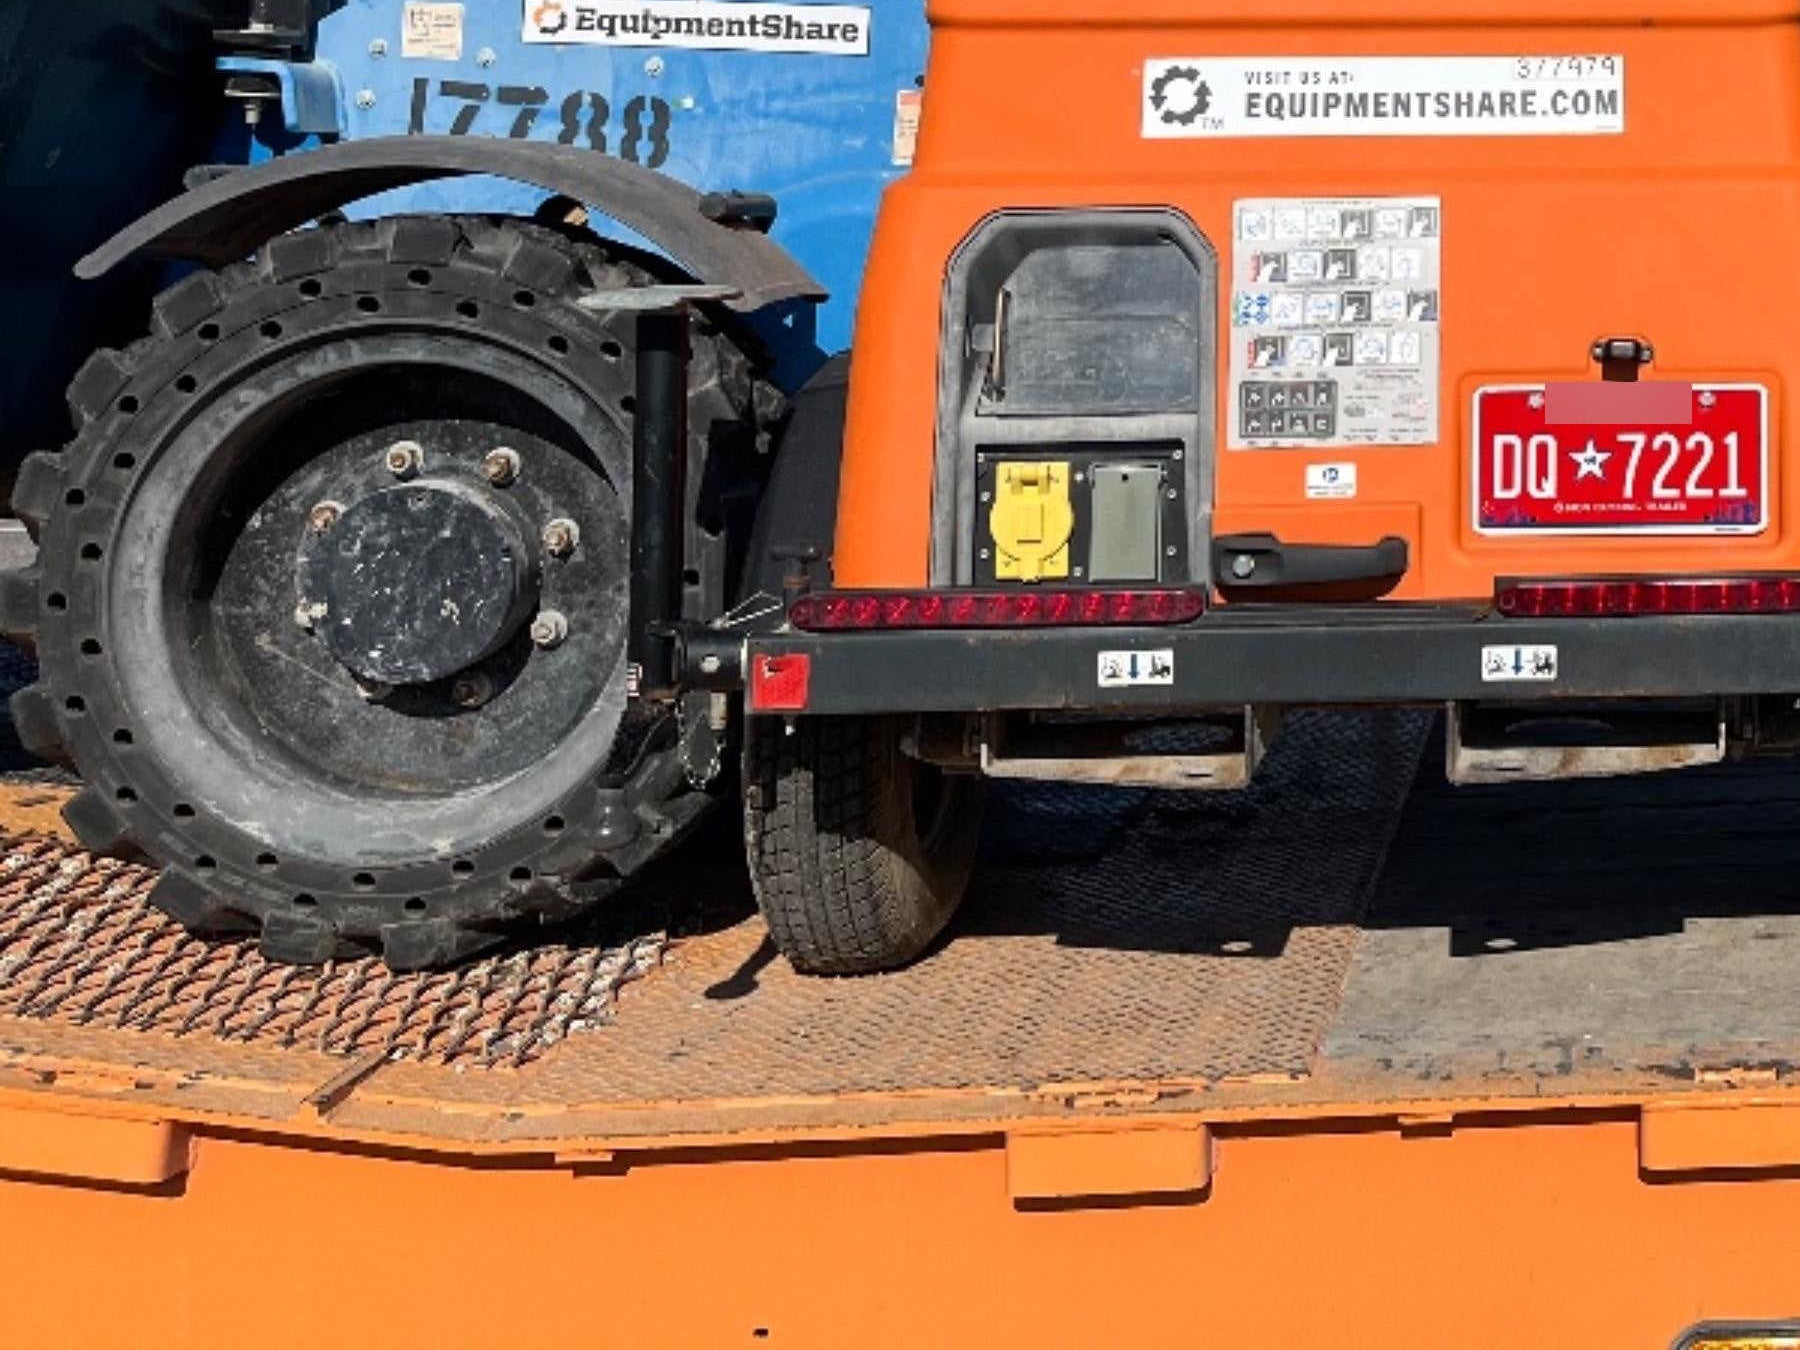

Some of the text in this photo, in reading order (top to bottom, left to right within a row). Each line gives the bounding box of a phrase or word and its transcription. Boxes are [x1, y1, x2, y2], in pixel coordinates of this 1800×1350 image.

[574, 5, 859, 44] EquipmentShare
[1300, 70, 1322, 85] US
[408, 77, 671, 170] 17788
[1244, 88, 1619, 120] EQUIPMENTSHARE.COM
[1492, 432, 1748, 499] DQ 7221
